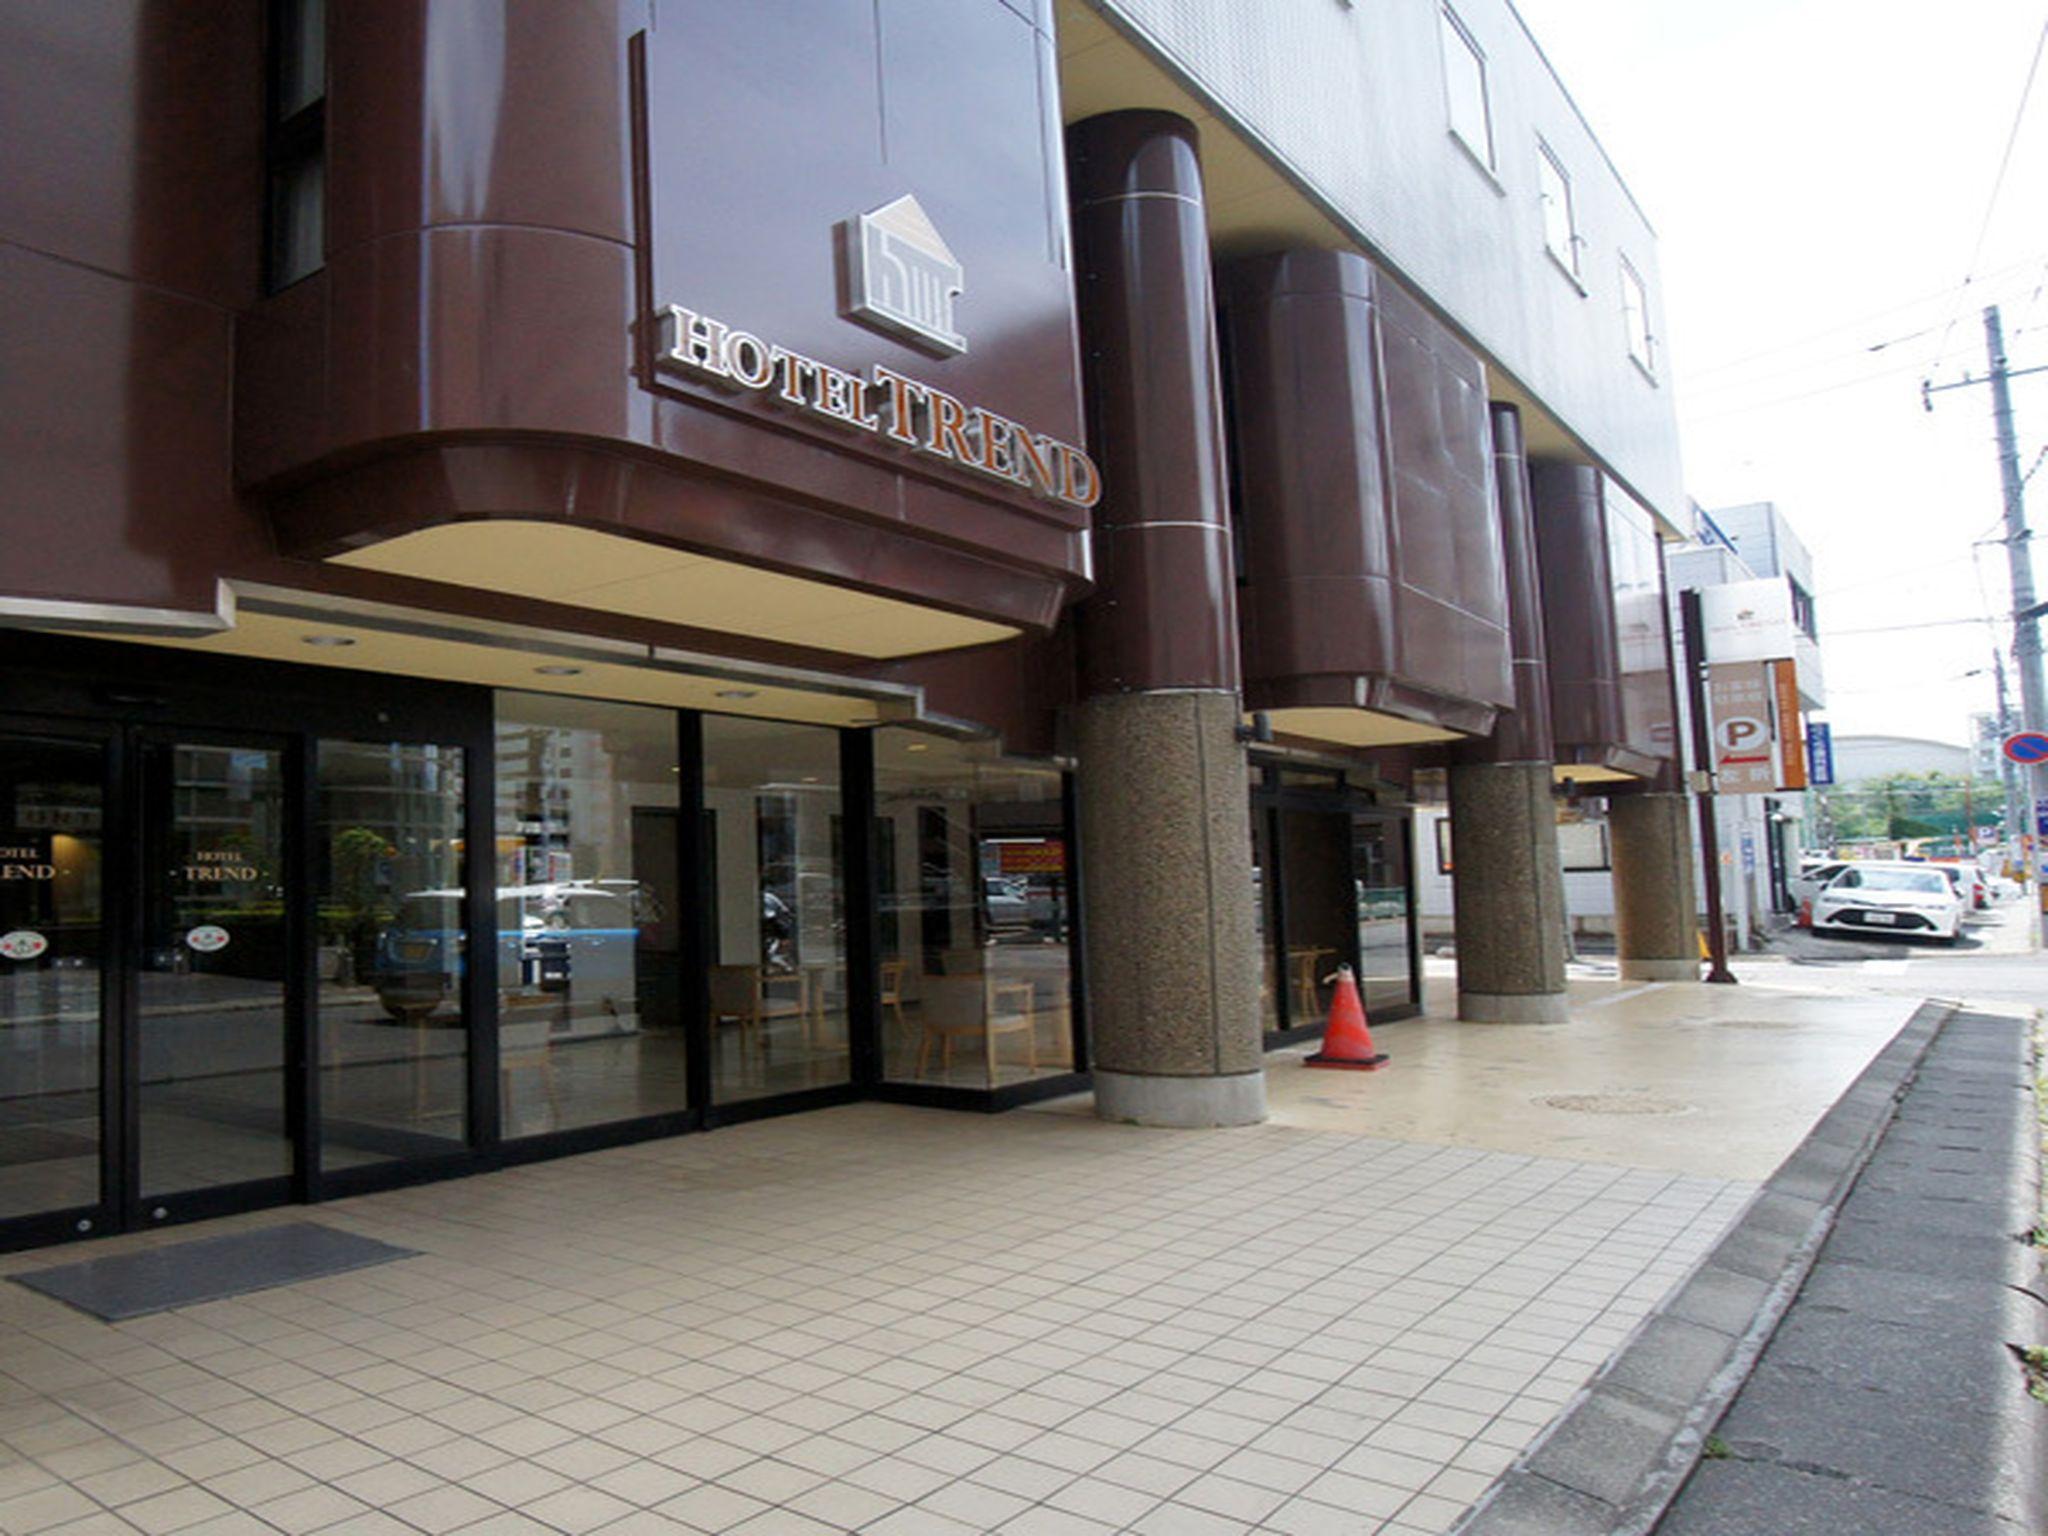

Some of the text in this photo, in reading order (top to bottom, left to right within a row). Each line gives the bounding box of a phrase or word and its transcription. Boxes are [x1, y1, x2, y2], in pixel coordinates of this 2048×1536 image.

[669, 304, 1101, 507] HOTEL TREND
[1727, 722, 1755, 747] P
[0, 848, 40, 859] OTEL
[197, 852, 243, 862] HOTEL
[0, 865, 56, 880] END
[185, 866, 258, 881] TREND
